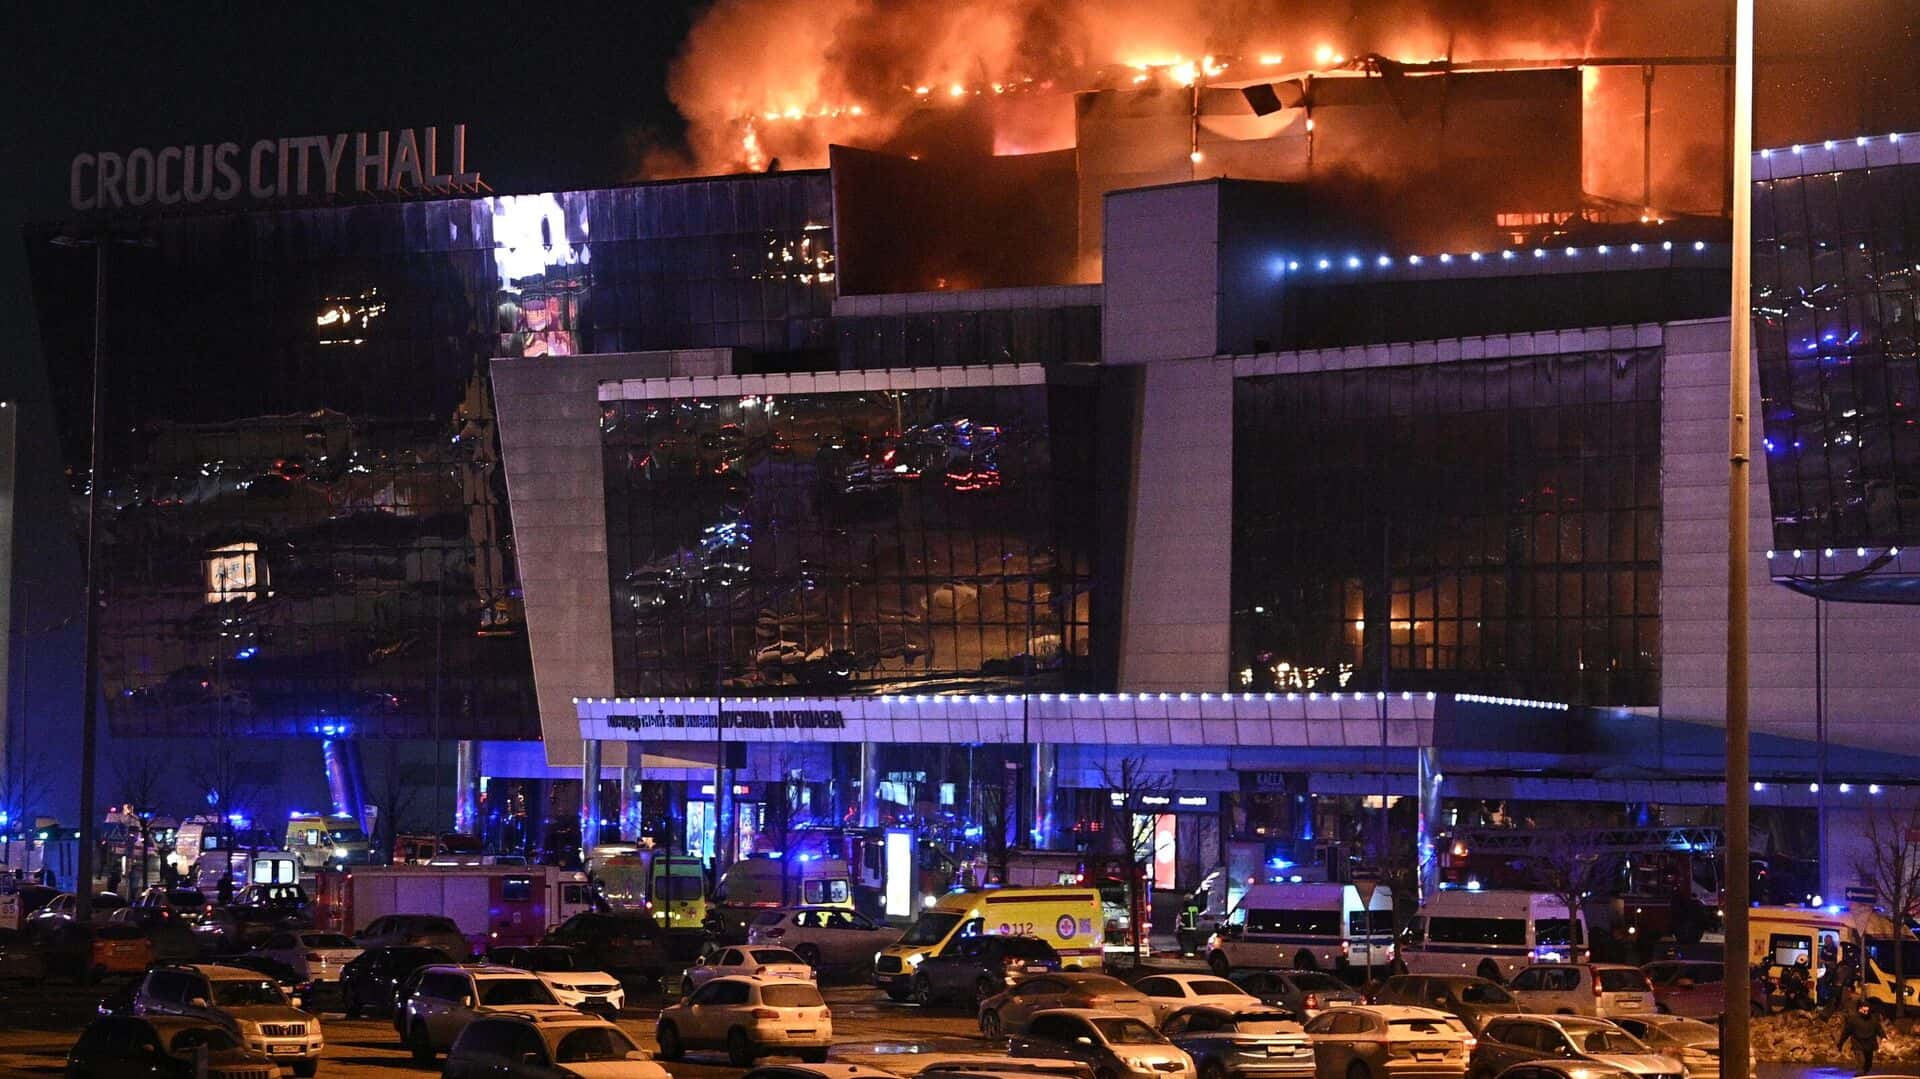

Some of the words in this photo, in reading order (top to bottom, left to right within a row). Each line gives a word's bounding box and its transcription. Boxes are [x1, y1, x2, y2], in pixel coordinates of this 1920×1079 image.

[71, 142, 242, 210] CROCUS
[250, 133, 348, 199] CITY
[355, 124, 480, 192] HALL
[1012, 922, 1033, 936] 112
